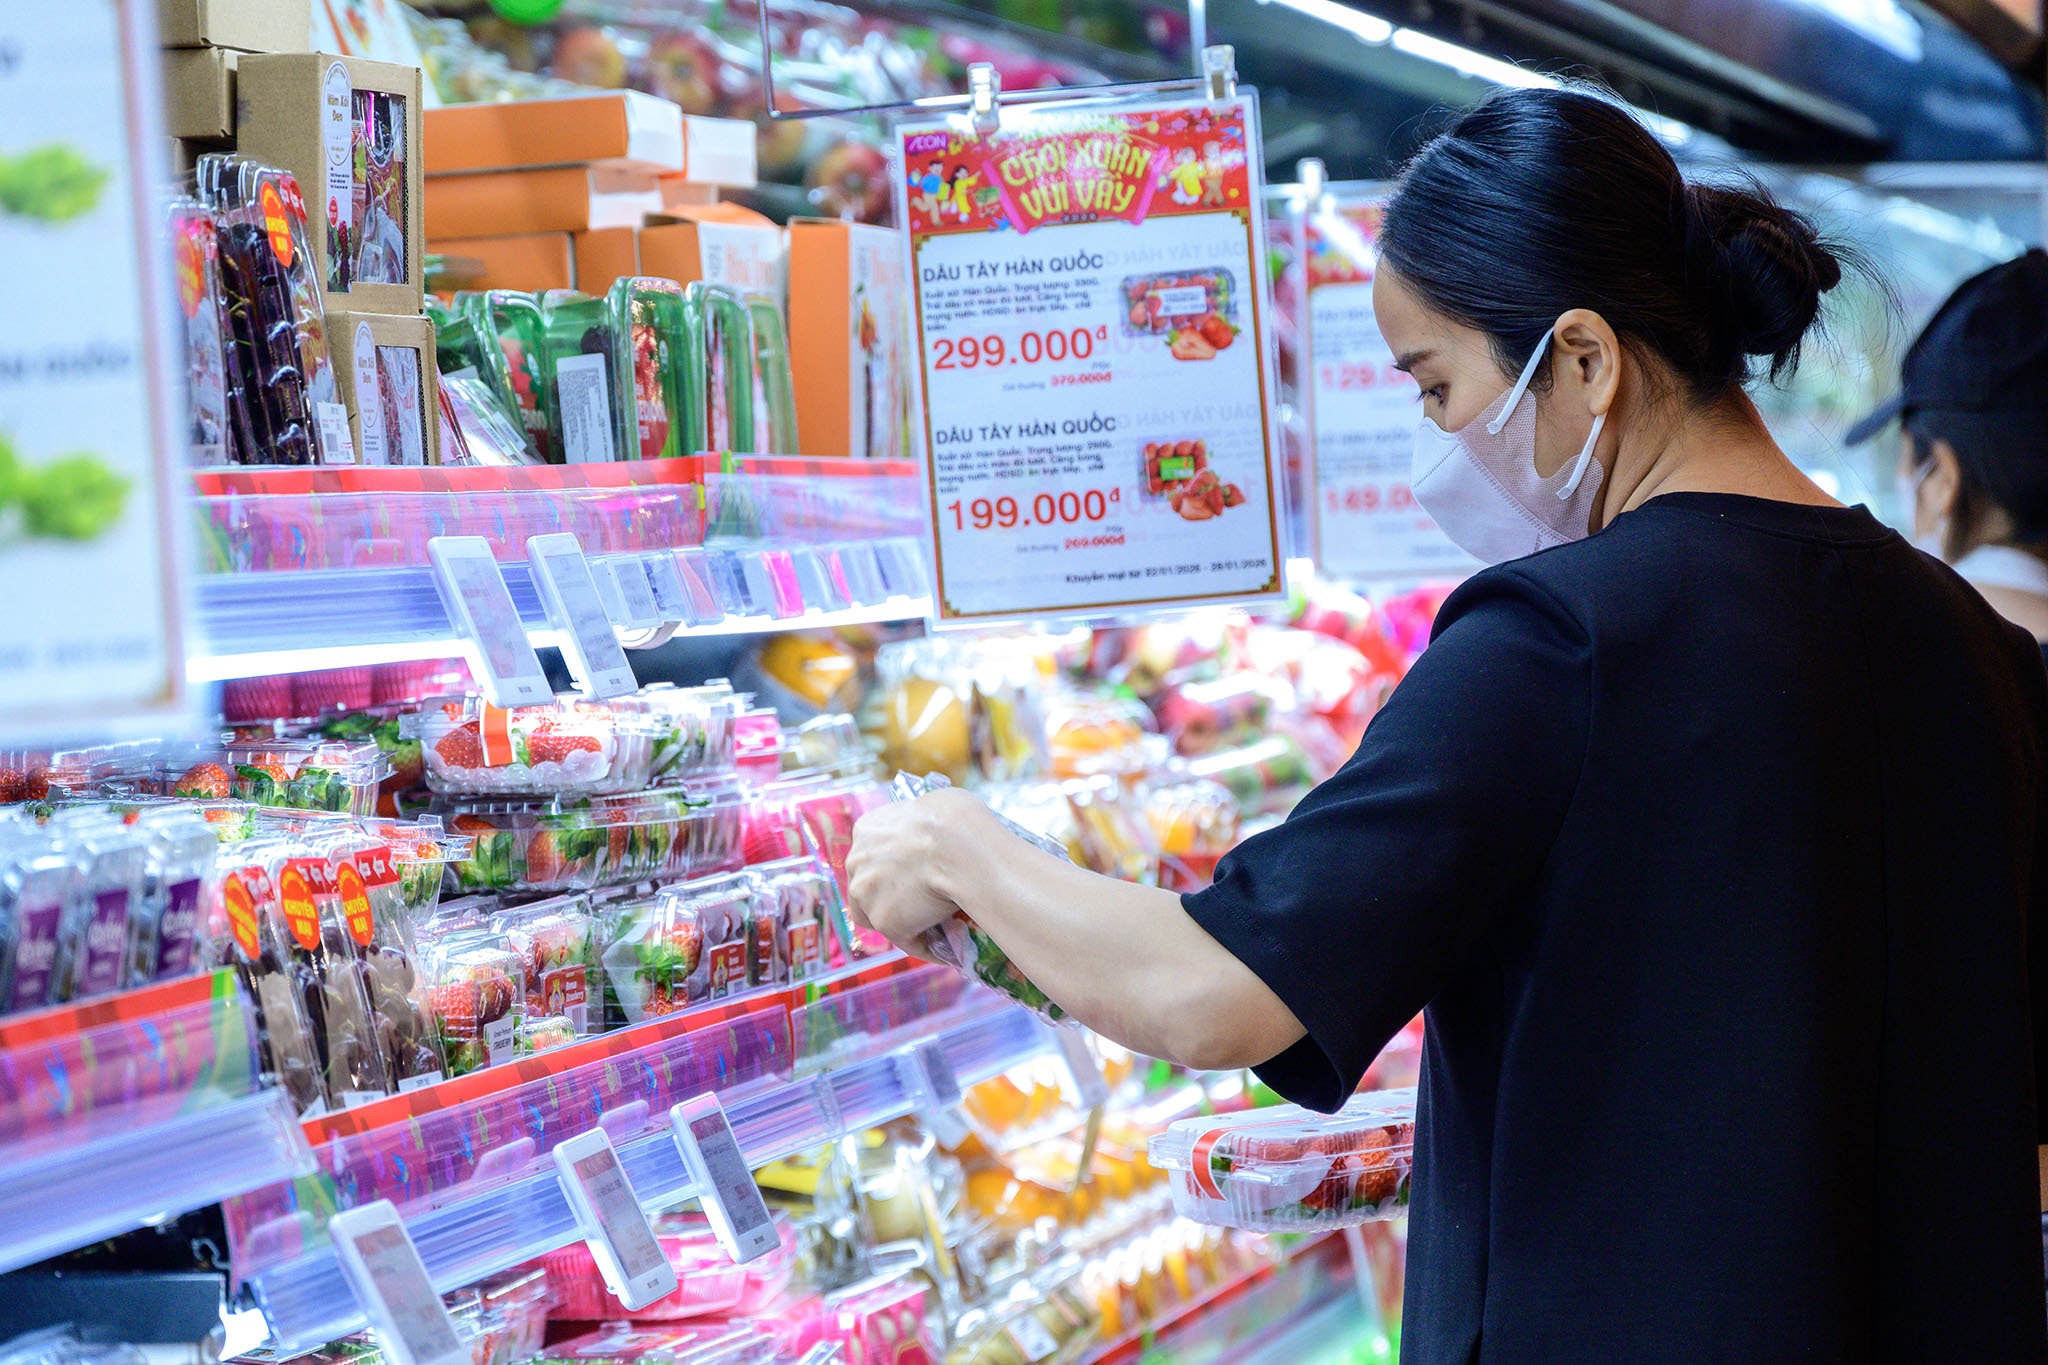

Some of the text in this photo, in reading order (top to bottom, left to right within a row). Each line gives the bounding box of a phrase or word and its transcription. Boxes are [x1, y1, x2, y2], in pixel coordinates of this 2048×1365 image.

[1073, 136, 1151, 178] XUÂN
[1019, 181, 1070, 219] VUI
[923, 263, 960, 282] DÂU
[966, 259, 1000, 279] TÂY
[1005, 256, 1043, 276] HÀN
[1050, 248, 1104, 272] QUỐC
[936, 411, 1116, 445] DÂU TÂY HÀN QUỐC
